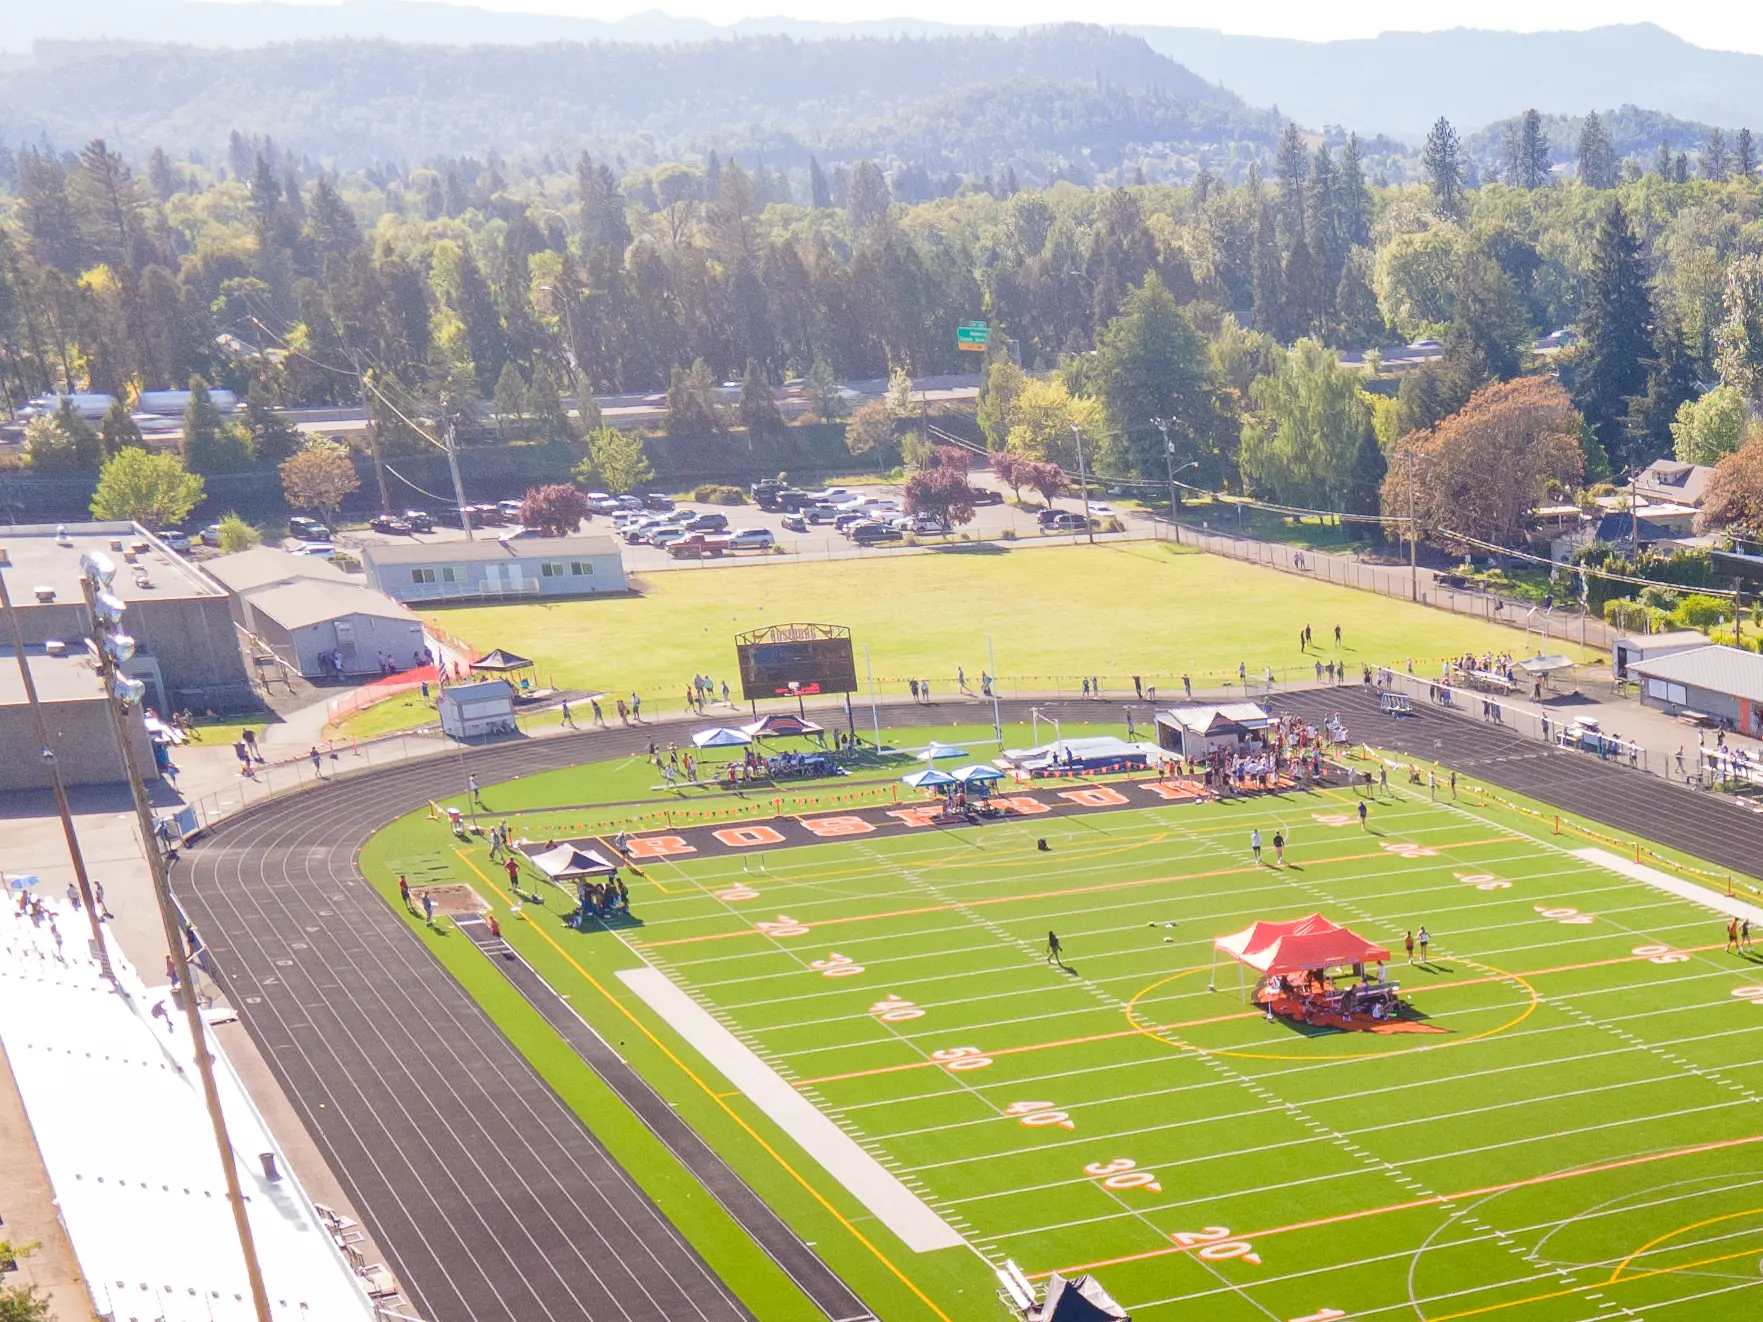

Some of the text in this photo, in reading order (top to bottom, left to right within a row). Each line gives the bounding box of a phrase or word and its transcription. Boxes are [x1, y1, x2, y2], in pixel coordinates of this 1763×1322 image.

[755, 916, 810, 937] 20
[1541, 907, 1595, 925] 40
[811, 954, 865, 978] 30
[1632, 944, 1691, 965] 50
[868, 999, 925, 1023] 40
[932, 1046, 993, 1071] 50
[1005, 1101, 1070, 1127] 40
[1083, 1158, 1155, 1191] 30
[1171, 1226, 1253, 1261] 20
